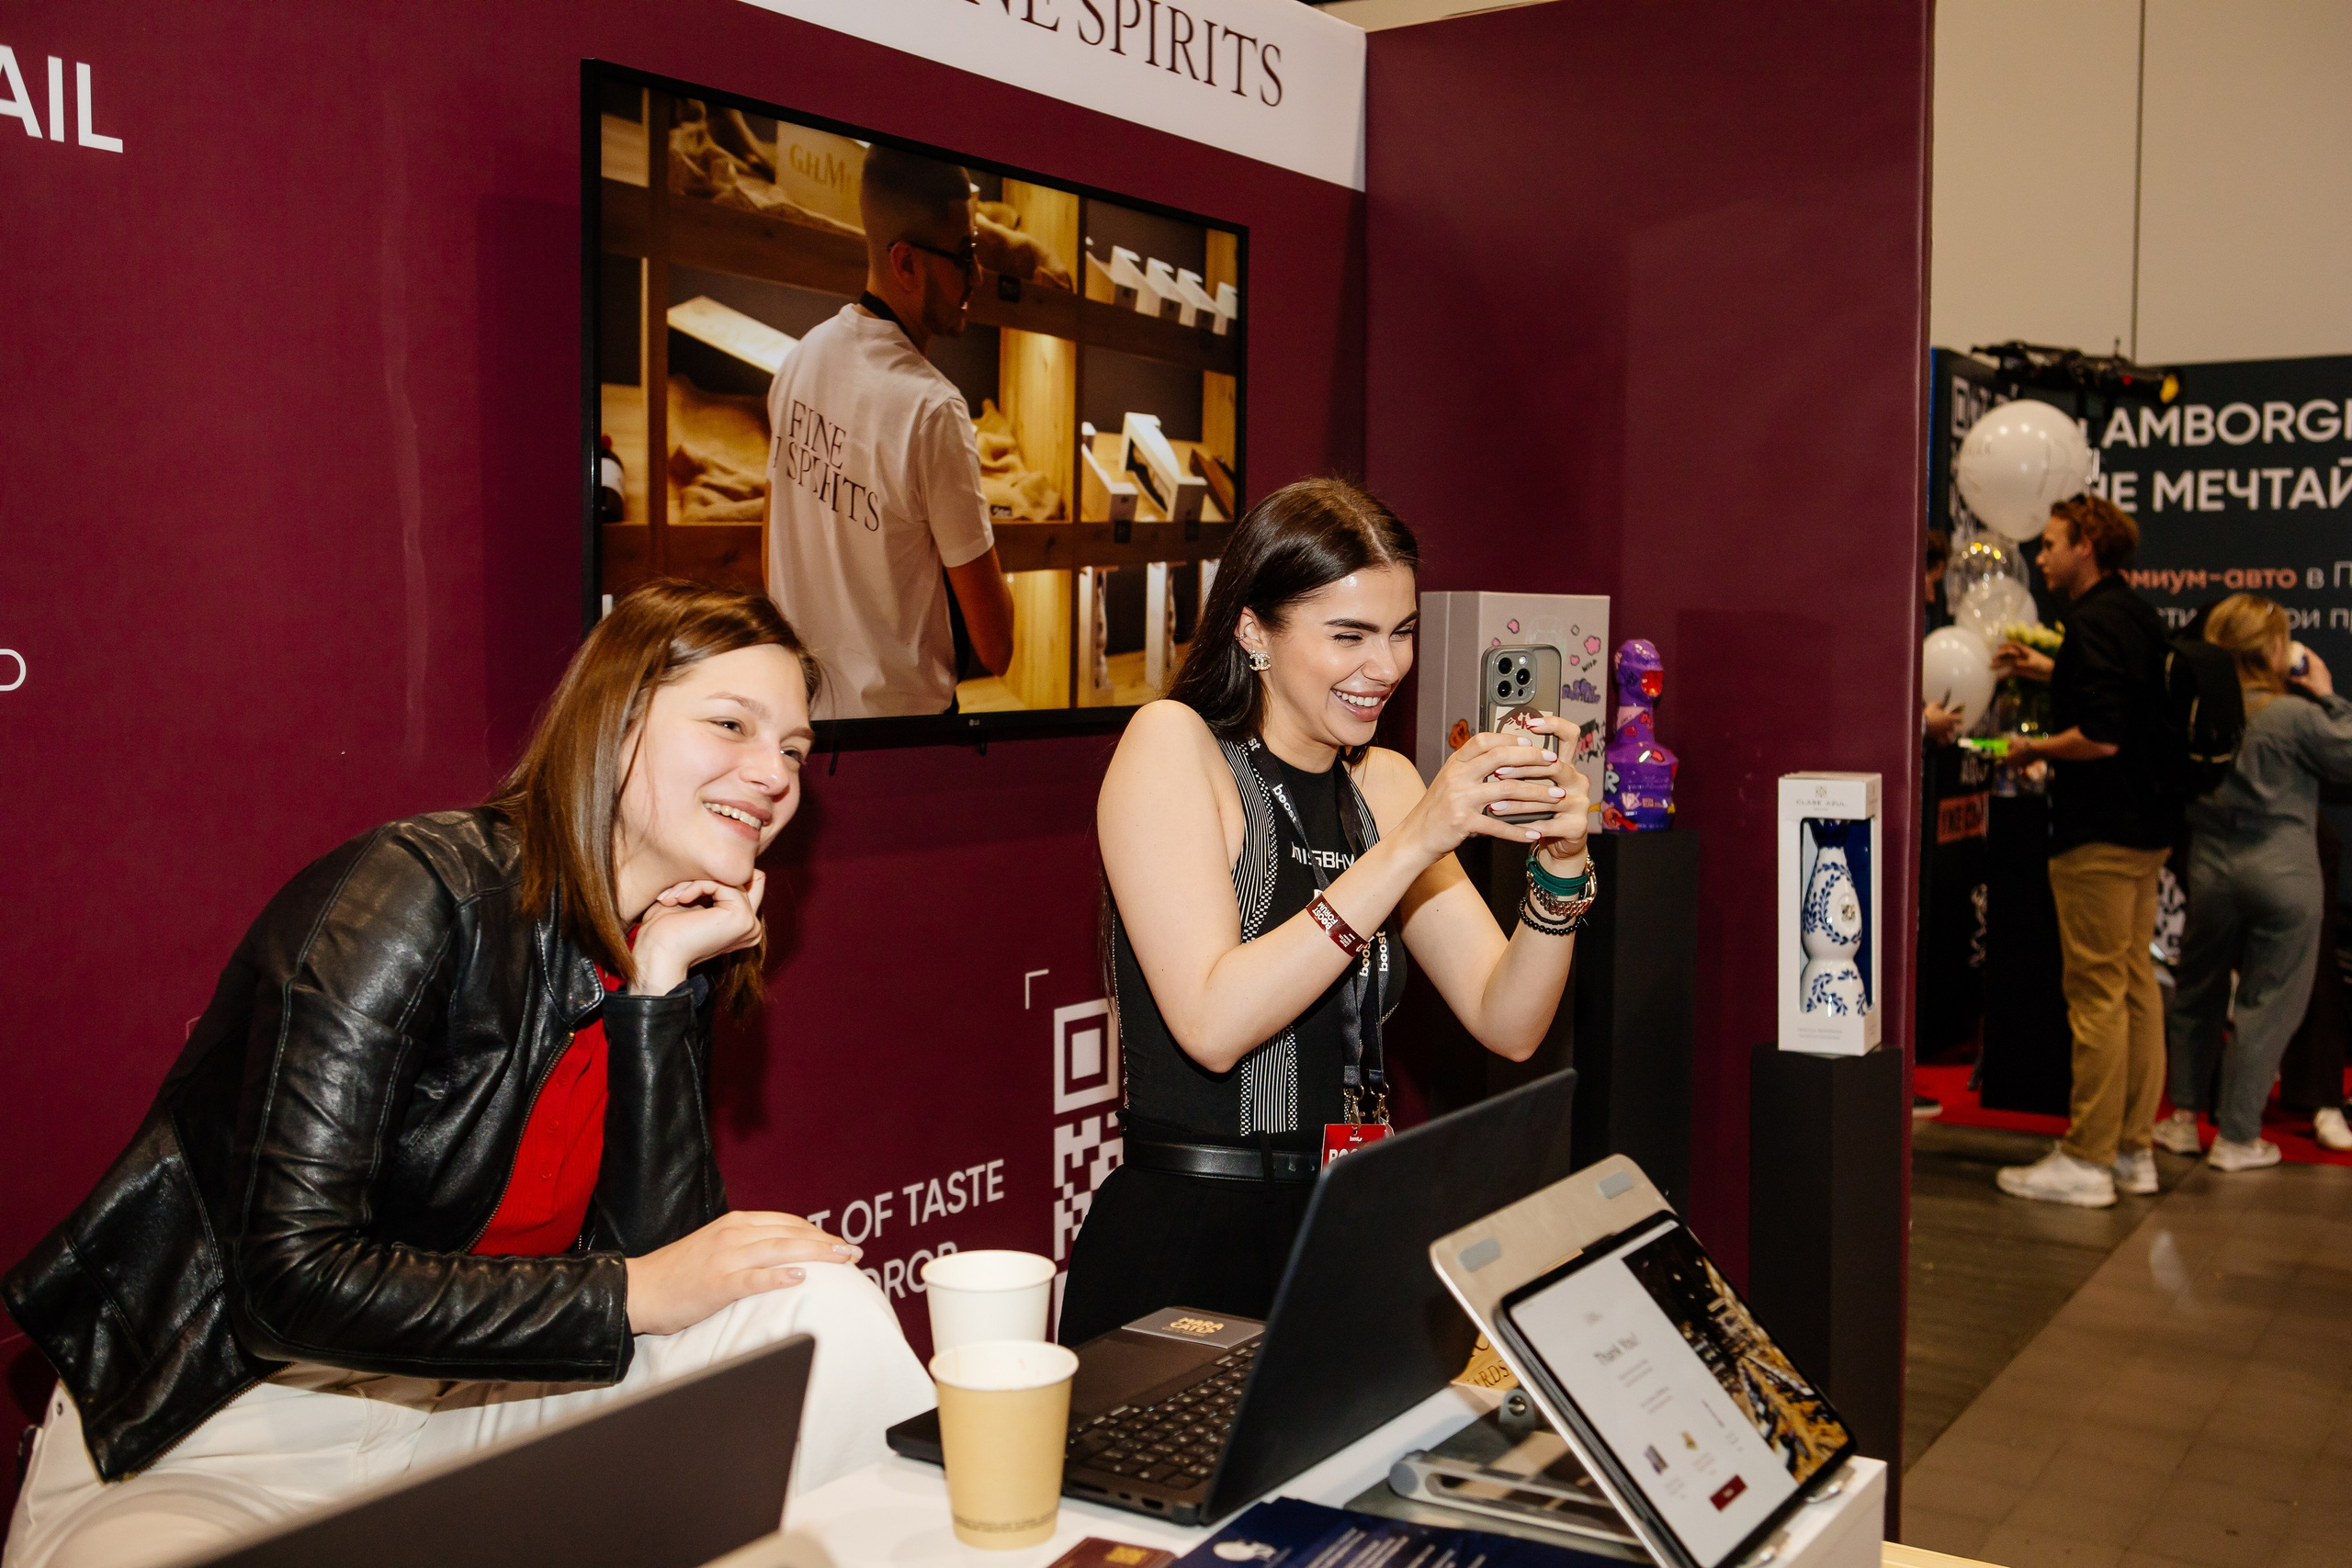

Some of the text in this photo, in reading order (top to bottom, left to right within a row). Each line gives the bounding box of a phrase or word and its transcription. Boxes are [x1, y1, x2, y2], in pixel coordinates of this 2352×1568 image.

[1077, 0, 1283, 107] SPIRITS
[788, 399, 846, 469] FINE
[2077, 398, 2352, 449] AMBORG
[2119, 568, 2298, 595] миум-авто
[1375, 931, 1388, 972] boost
[842, 1191, 893, 1246] OF
[902, 1158, 1005, 1227] TASTE
